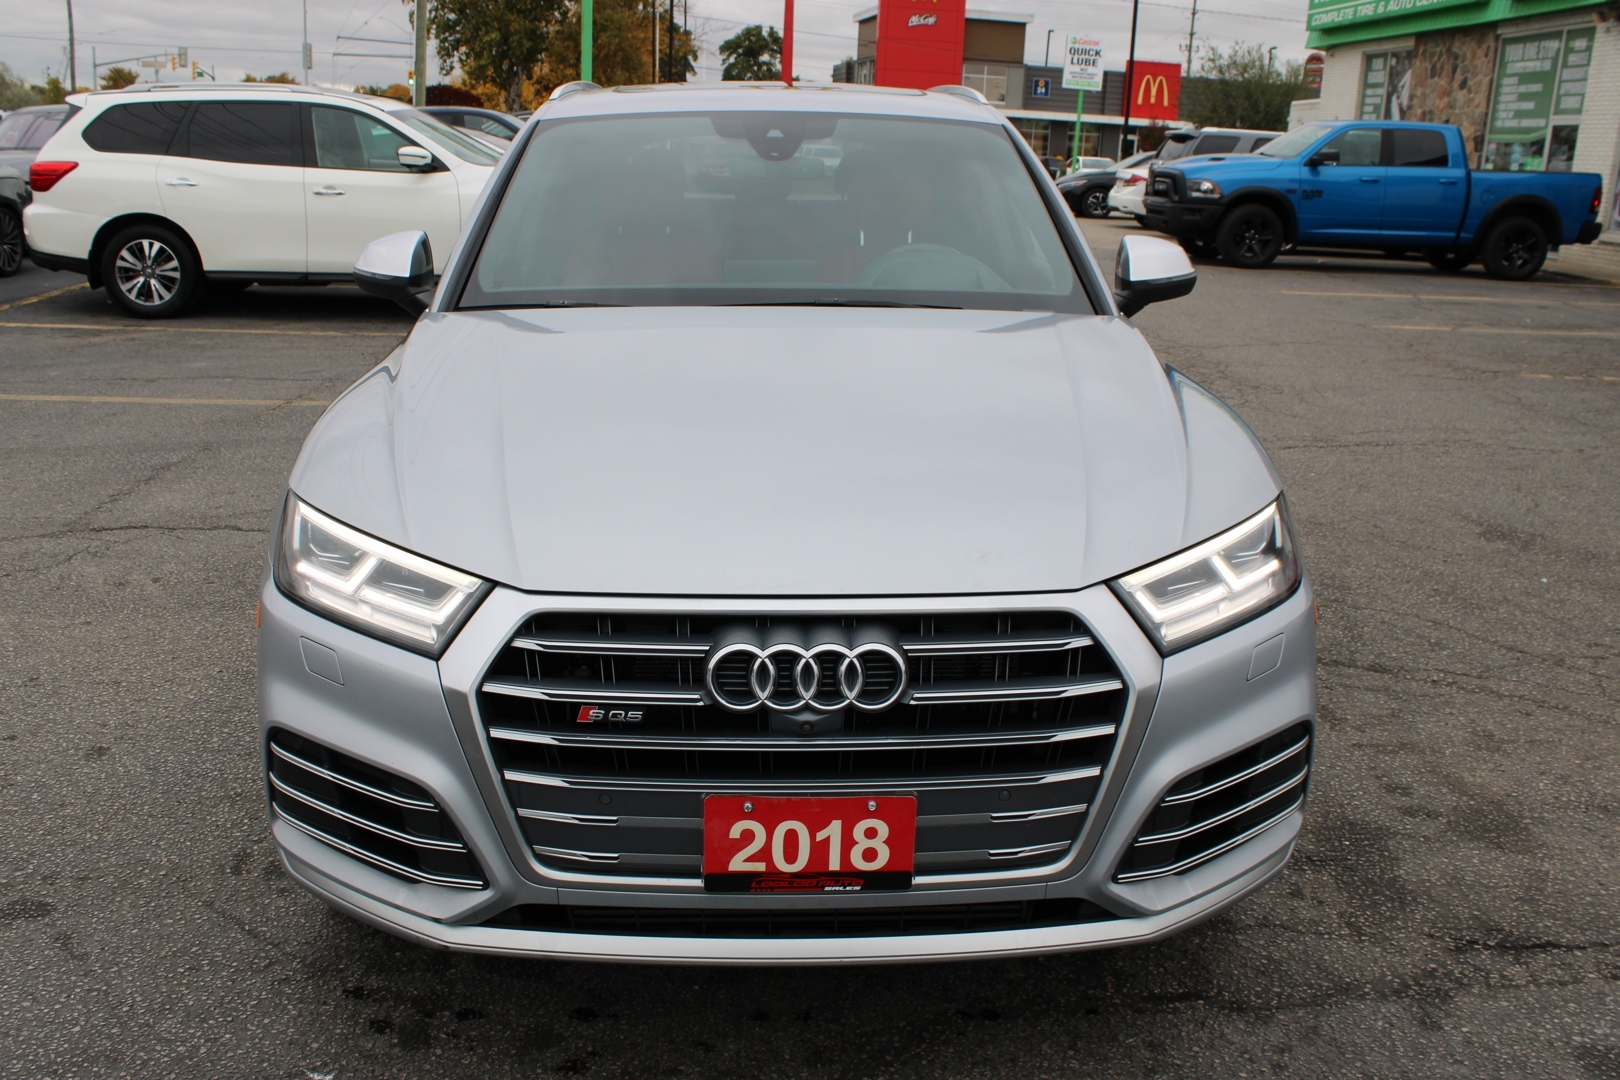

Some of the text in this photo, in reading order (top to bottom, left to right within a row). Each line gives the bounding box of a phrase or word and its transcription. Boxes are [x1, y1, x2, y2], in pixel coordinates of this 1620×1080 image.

[1311, 7, 1355, 26] COMPLETE
[1356, 4, 1375, 18] TIRE
[1377, 2, 1385, 13] &
[1386, 0, 1414, 12] AUTO
[1077, 37, 1100, 47] Castrol
[1069, 46, 1102, 58] QUICK
[1070, 57, 1098, 67] LUBE
[728, 818, 890, 873] 2018
[818, 879, 865, 887] AUTO
